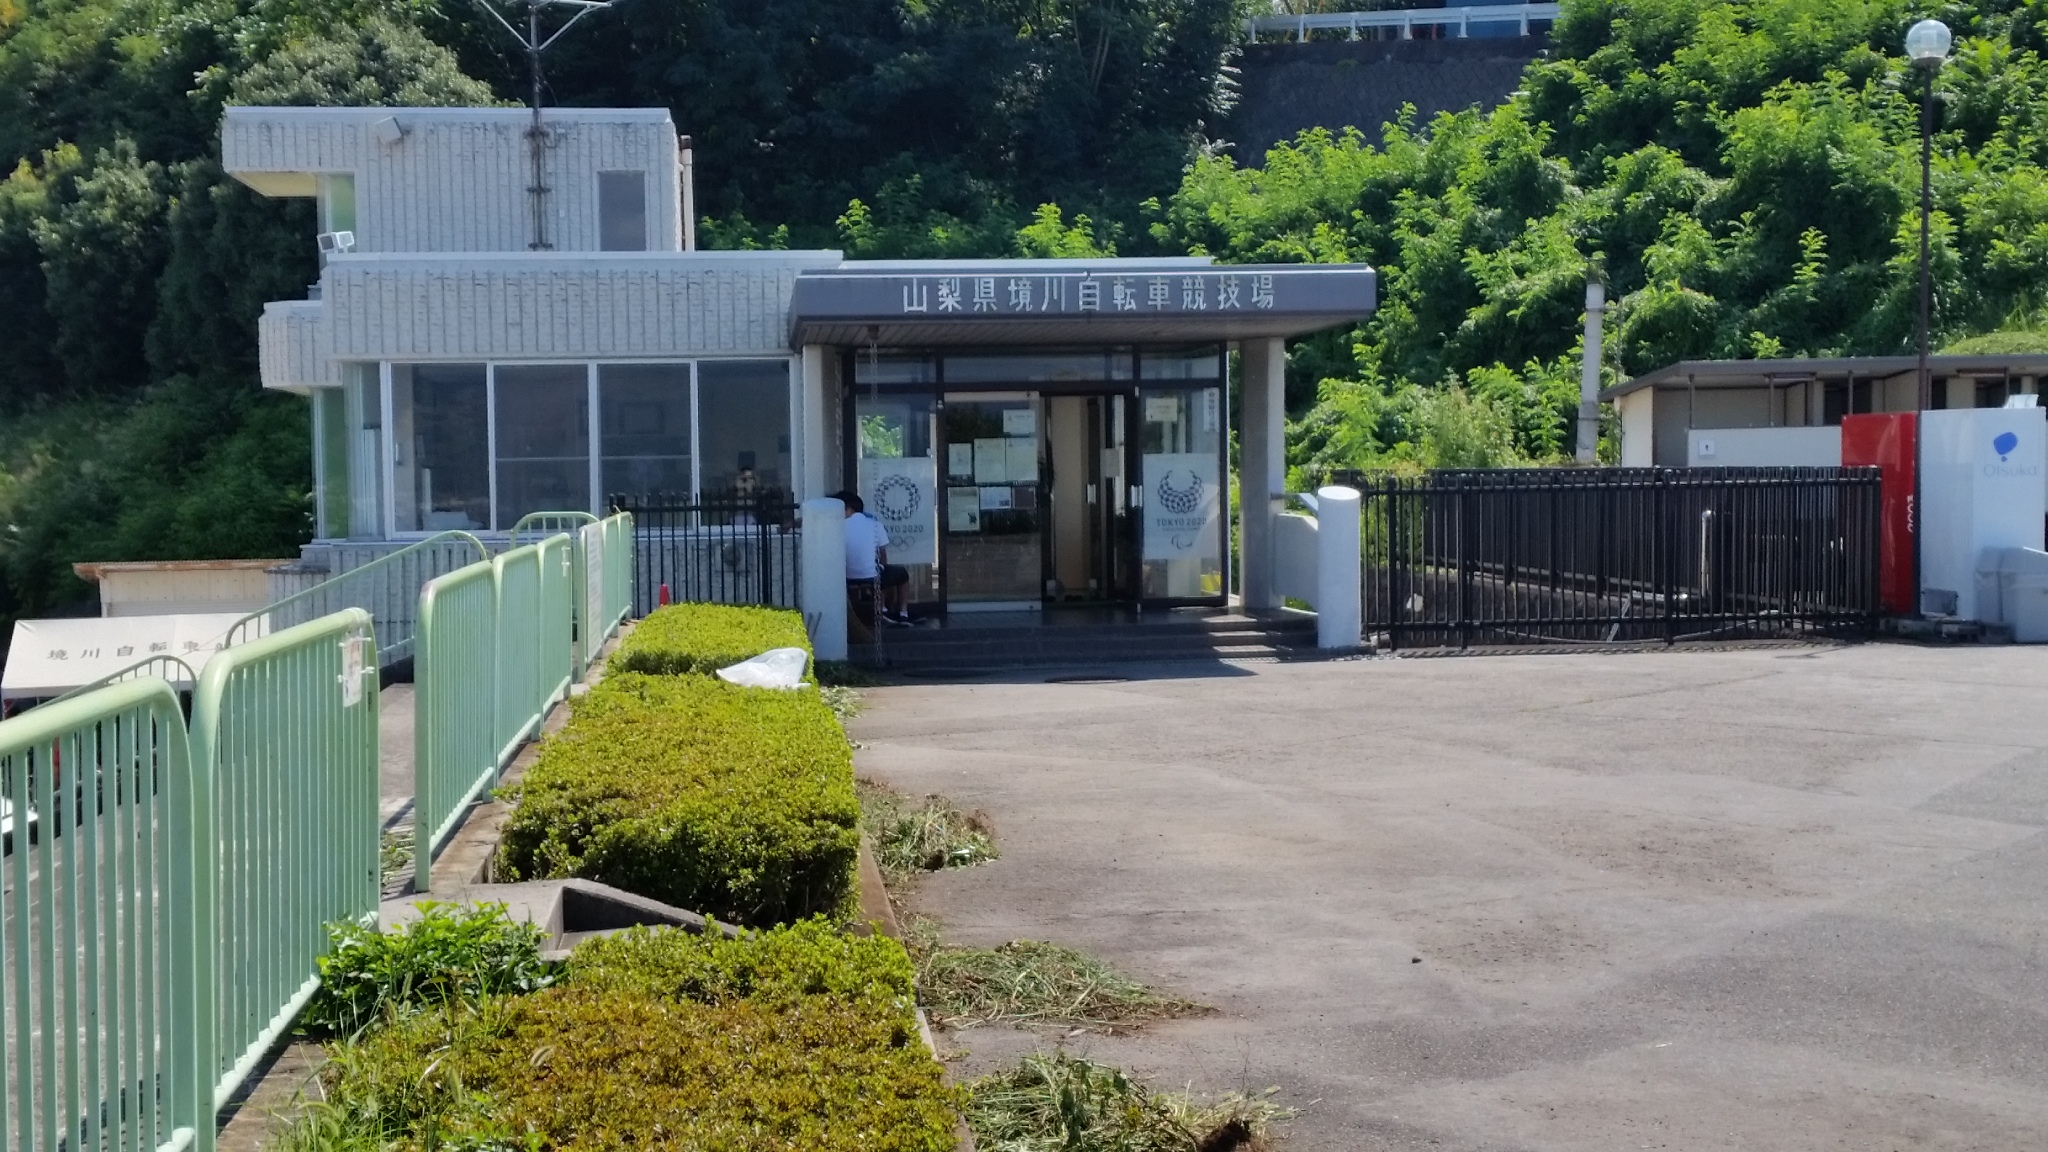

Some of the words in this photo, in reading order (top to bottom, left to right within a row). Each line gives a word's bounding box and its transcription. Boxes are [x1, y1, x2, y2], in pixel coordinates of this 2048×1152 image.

[903, 275, 1275, 313] 山梨県境川自転車競技場
[1156, 518, 1185, 526] TOKYO
[1186, 517, 1207, 525] 2020
[902, 524, 924, 533] 2020
